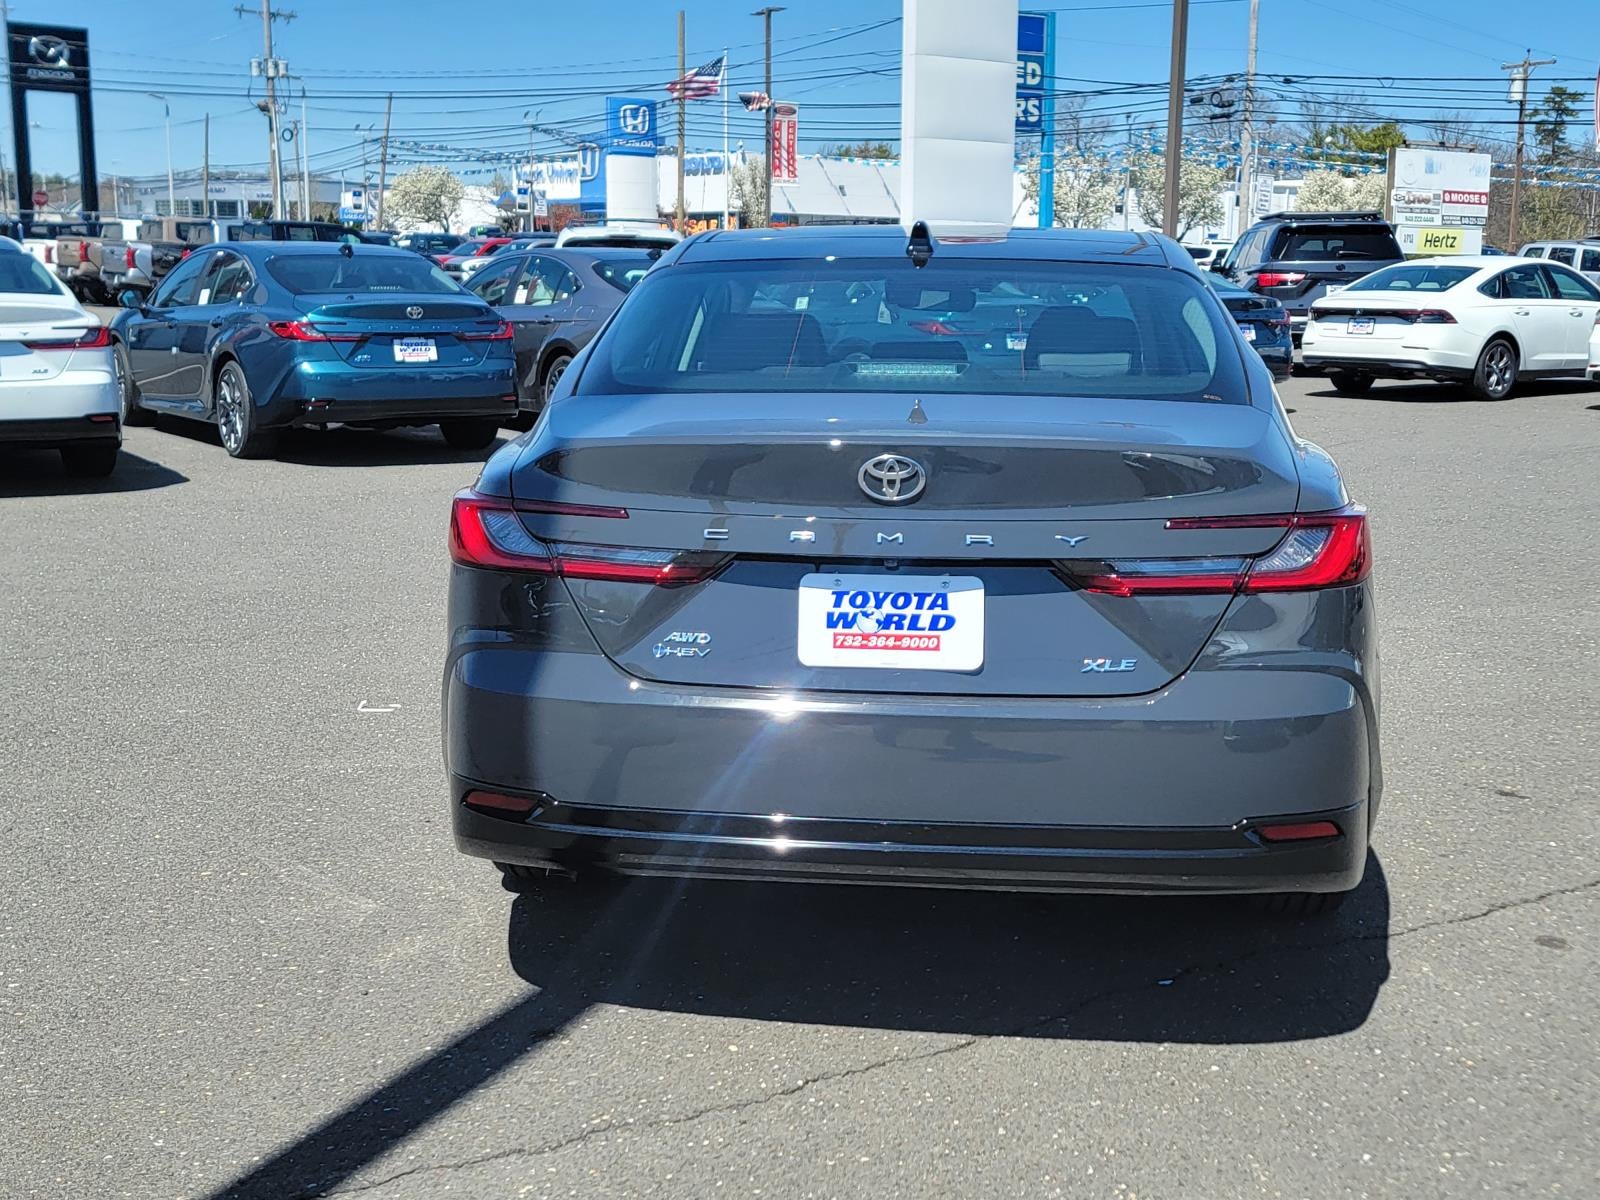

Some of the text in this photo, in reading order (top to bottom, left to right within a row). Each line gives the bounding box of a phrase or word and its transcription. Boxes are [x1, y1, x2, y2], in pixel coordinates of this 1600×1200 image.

[1451, 192, 1480, 203] MOOSE
[1424, 233, 1457, 248] Hertz
[831, 591, 950, 610] TOYOTA
[664, 632, 711, 643] AWD
[835, 636, 938, 648] 732-364-9000
[1080, 659, 1137, 673] XLE
